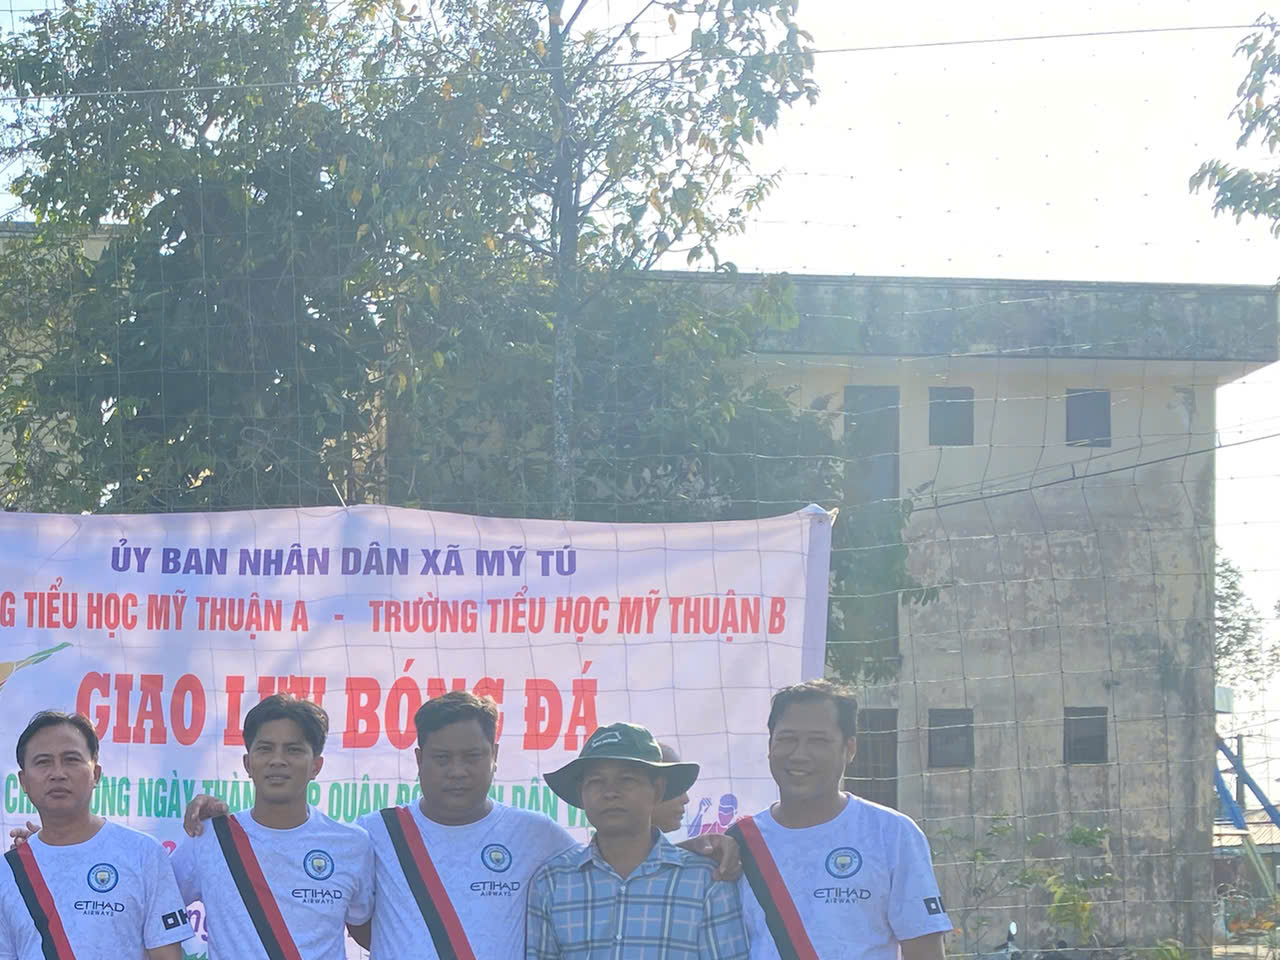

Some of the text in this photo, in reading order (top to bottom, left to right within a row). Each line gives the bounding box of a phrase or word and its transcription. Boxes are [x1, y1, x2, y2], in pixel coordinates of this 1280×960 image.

[111, 538, 577, 577] ỦY BAN NHÂN DÂN XÃ MỸ TÚ
[23, 576, 78, 630] TIỂU
[87, 592, 138, 638] HỌC
[146, 589, 187, 632] MỸ
[196, 592, 282, 640] THUẬN
[290, 599, 309, 632] A
[369, 591, 478, 635] TRƯỜNG
[487, 585, 546, 635] TIỂU
[554, 596, 610, 643] HỌC
[617, 589, 662, 635] MỸ
[668, 589, 761, 643] THUẬN
[769, 596, 786, 635] B
[76, 671, 206, 746] GIAO
[523, 660, 598, 751] ĐÁ
[137, 770, 195, 819] NGÀY
[292, 888, 342, 899] ETIHAD
[470, 880, 520, 891] ETIHAD
[813, 887, 871, 899] ETIHAD
[72, 901, 125, 912] ETIHAD
